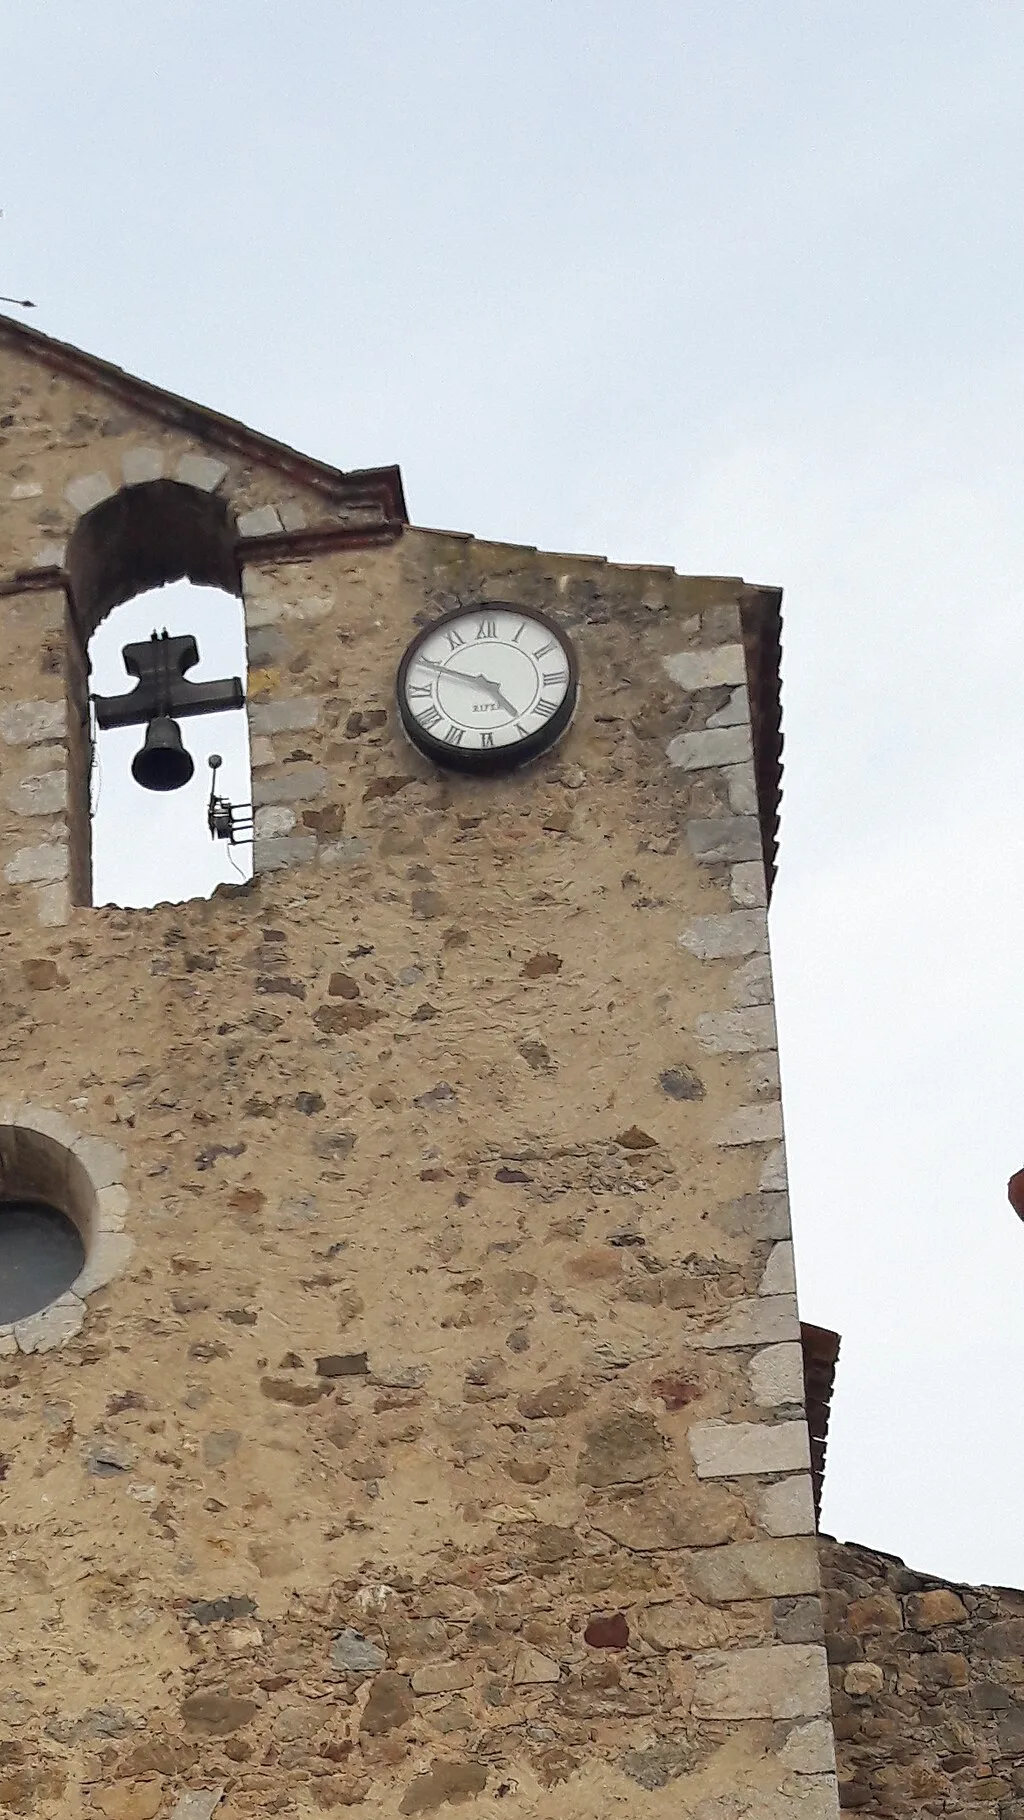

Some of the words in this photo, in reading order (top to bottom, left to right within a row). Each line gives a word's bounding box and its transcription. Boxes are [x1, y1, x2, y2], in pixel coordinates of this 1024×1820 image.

[443, 629, 466, 650] XI
[474, 619, 498, 640] XII
[511, 622, 526, 643] I
[532, 640, 558, 661] II
[543, 670, 567, 687] III
[408, 682, 434, 698] IX
[415, 705, 445, 731] VIII
[531, 697, 558, 718] IIII
[443, 725, 466, 746] VII
[479, 732, 494, 748] VI
[513, 723, 530, 739] V
